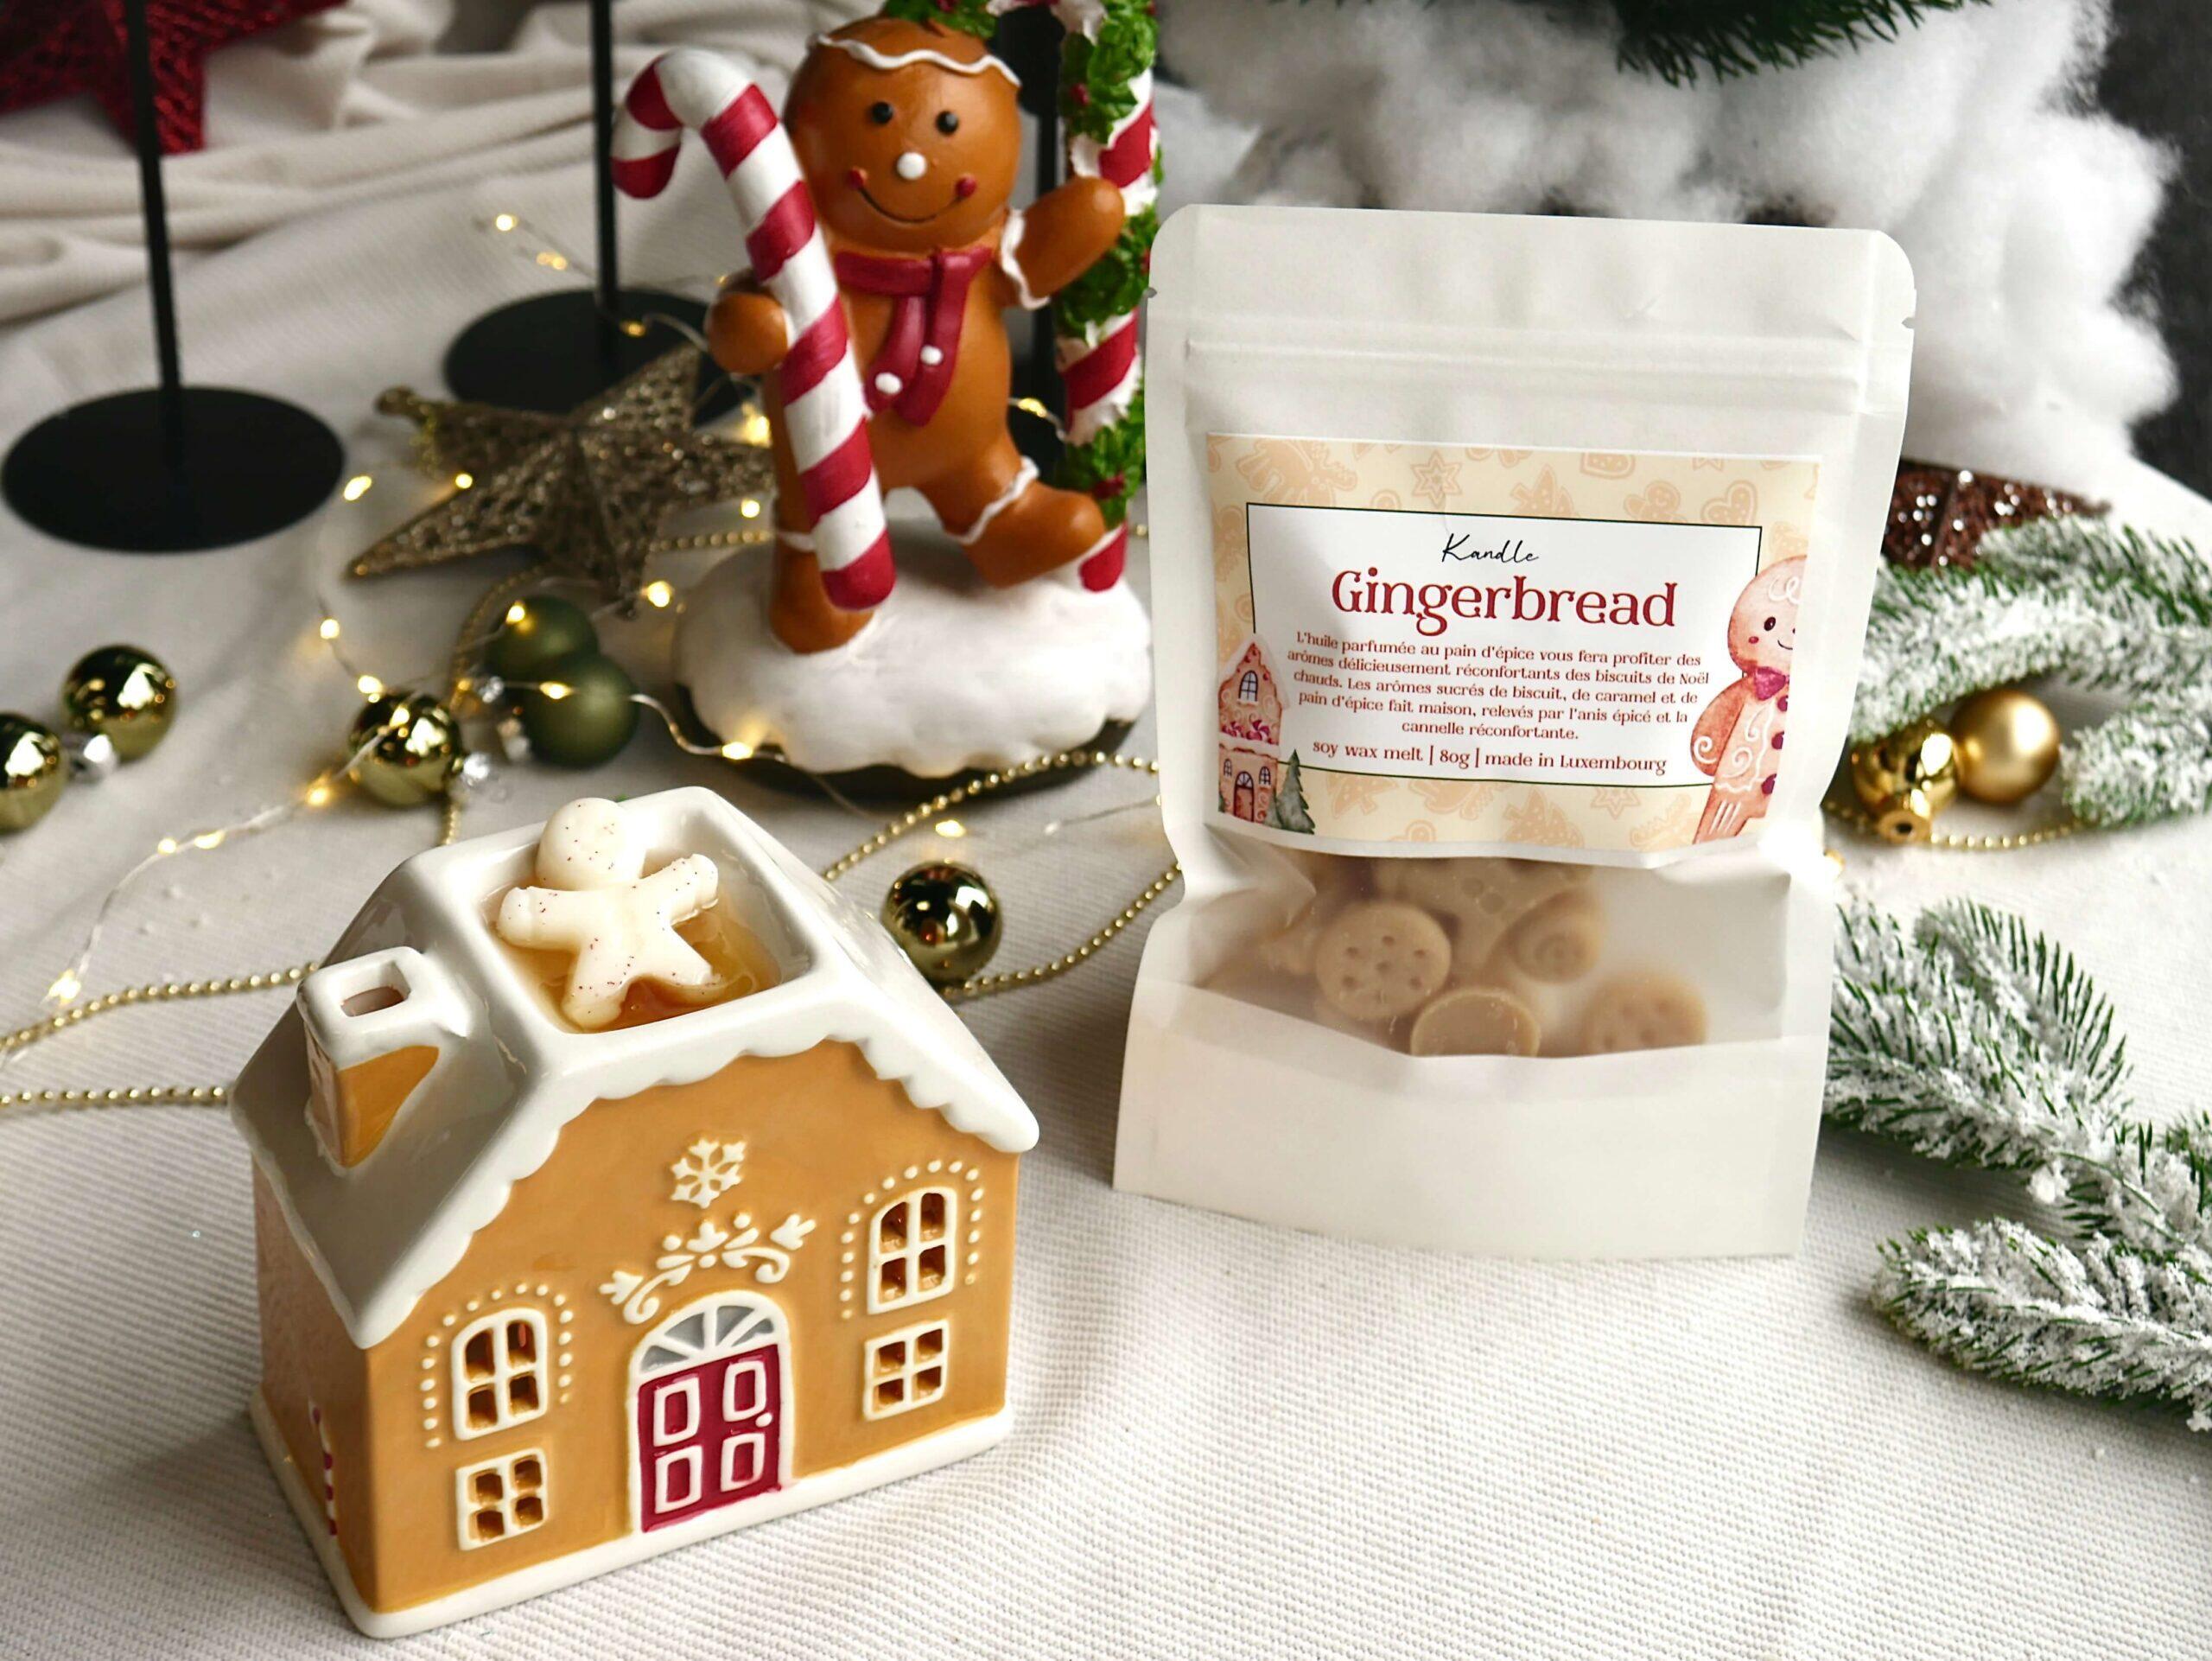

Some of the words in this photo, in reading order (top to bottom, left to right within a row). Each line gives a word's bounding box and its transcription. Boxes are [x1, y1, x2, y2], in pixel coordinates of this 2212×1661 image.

[1441, 532, 1540, 563] Kandle
[1332, 566, 1679, 637] Gingerbread
[1297, 631, 1339, 650] L'huile
[1341, 640, 1416, 655] parfumée
[1421, 645, 1440, 656] au
[1444, 644, 1477, 661] pain
[1481, 645, 1535, 664] d'épice
[1539, 651, 1573, 662] vous
[1579, 649, 1608, 664] fera
[1612, 652, 1672, 668] profiter
[1676, 653, 1701, 666] des
[1287, 650, 1334, 667] arômes
[1338, 657, 1452, 676] délicieusement
[1456, 663, 1560, 681] réconfortants
[1565, 668, 1591, 682] des
[1595, 669, 1652, 684] biscuits
[1656, 671, 1675, 684] de
[1680, 671, 1709, 685] Noël
[1294, 669, 1343, 688] chauds.
[1348, 678, 1371, 690] Les
[1376, 679, 1432, 694] arômes
[1436, 683, 1484, 697] sucrés
[1489, 684, 1508, 698] de
[1512, 685, 1567, 702] biscuit,
[1572, 688, 1591, 701] de
[1595, 690, 1656, 703] caramel
[1661, 692, 1676, 704] et
[1681, 691, 1698, 703] de
[1299, 690, 1327, 705] pain
[1332, 695, 1383, 713] d'épice
[1389, 698, 1414, 713] fait
[1419, 701, 1477, 717] maison,
[1482, 704, 1534, 719] relevés
[1537, 709, 1565, 723] par
[1569, 706, 1607, 722] l'anis
[1612, 709, 1651, 726] épicé
[1656, 711, 1671, 723] et
[1675, 710, 1688, 723] la
[1402, 722, 1465, 735] cannelle
[1469, 722, 1579, 740] réconfortante.
[1313, 741, 1338, 758] soy
[1344, 745, 1378, 759] wax
[1383, 747, 1424, 761] melt
[1440, 749, 1471, 770] 80g
[1484, 752, 1533, 767] made
[1538, 752, 1554, 767] in
[1560, 754, 1667, 777] Luxembourg
